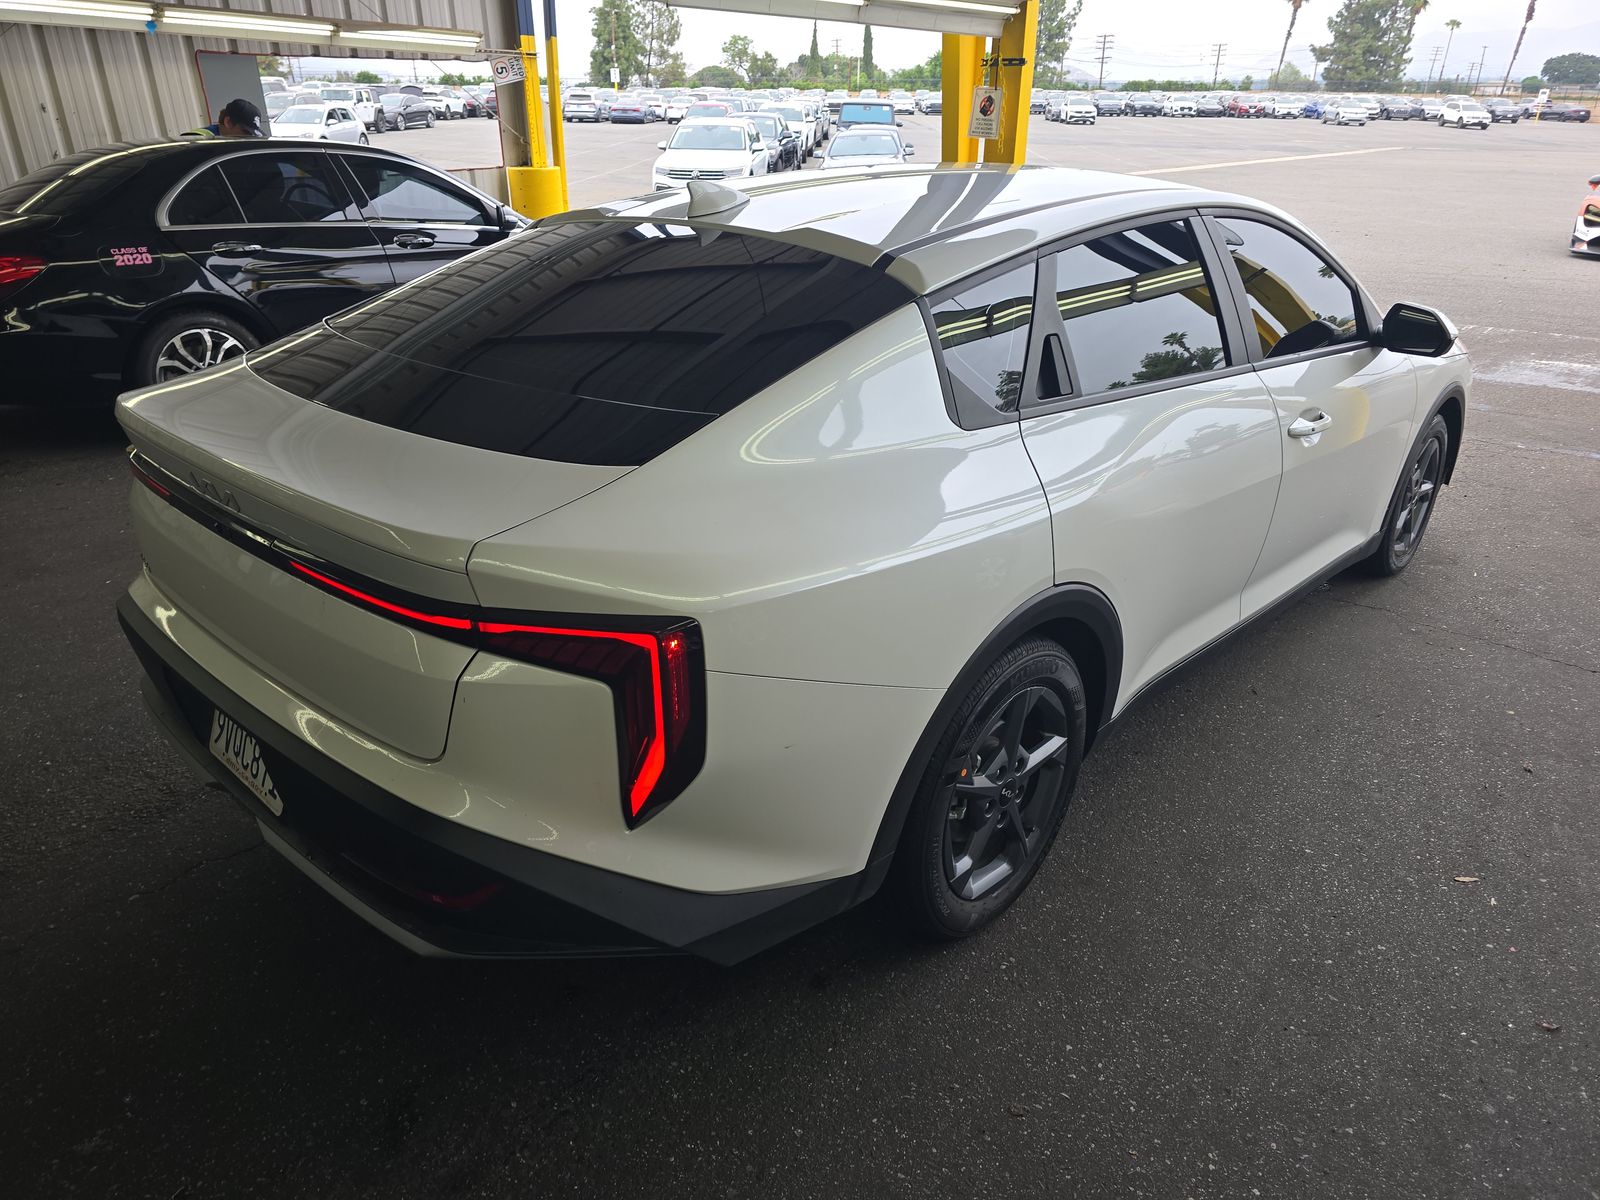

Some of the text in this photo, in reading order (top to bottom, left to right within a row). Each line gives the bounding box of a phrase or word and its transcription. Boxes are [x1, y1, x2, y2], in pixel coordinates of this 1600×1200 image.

[496, 66, 508, 75] 5
[507, 57, 519, 77] LIMIT
[513, 56, 525, 77] SPEED
[110, 247, 137, 255] CLASS
[114, 253, 153, 267] 2020
[214, 709, 278, 801] 9VQC8
